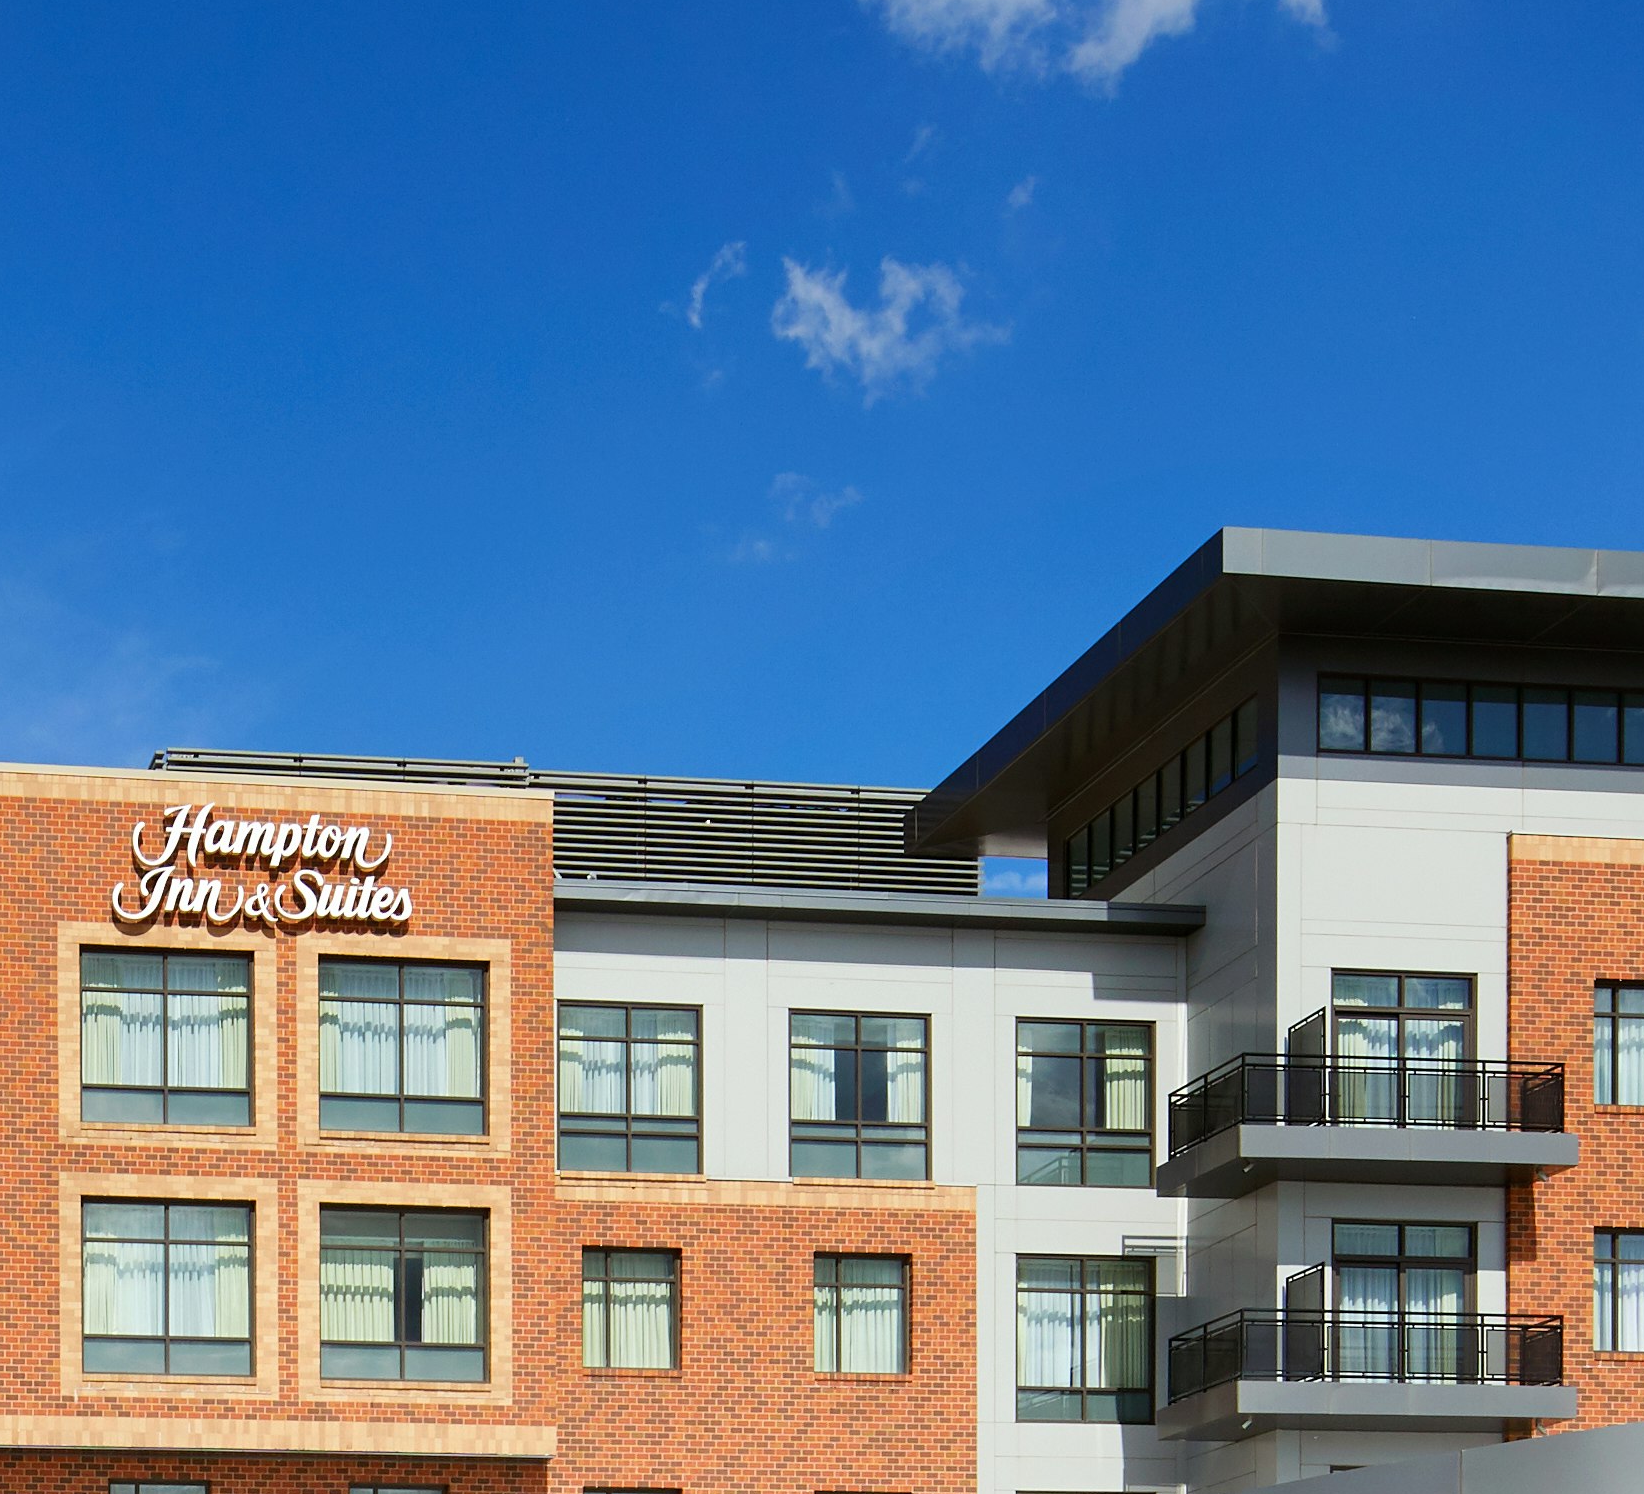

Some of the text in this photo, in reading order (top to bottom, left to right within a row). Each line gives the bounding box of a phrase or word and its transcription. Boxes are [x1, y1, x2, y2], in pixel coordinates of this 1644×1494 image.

[132, 801, 393, 871] Hampton
[111, 865, 413, 923] Inn & Suites
